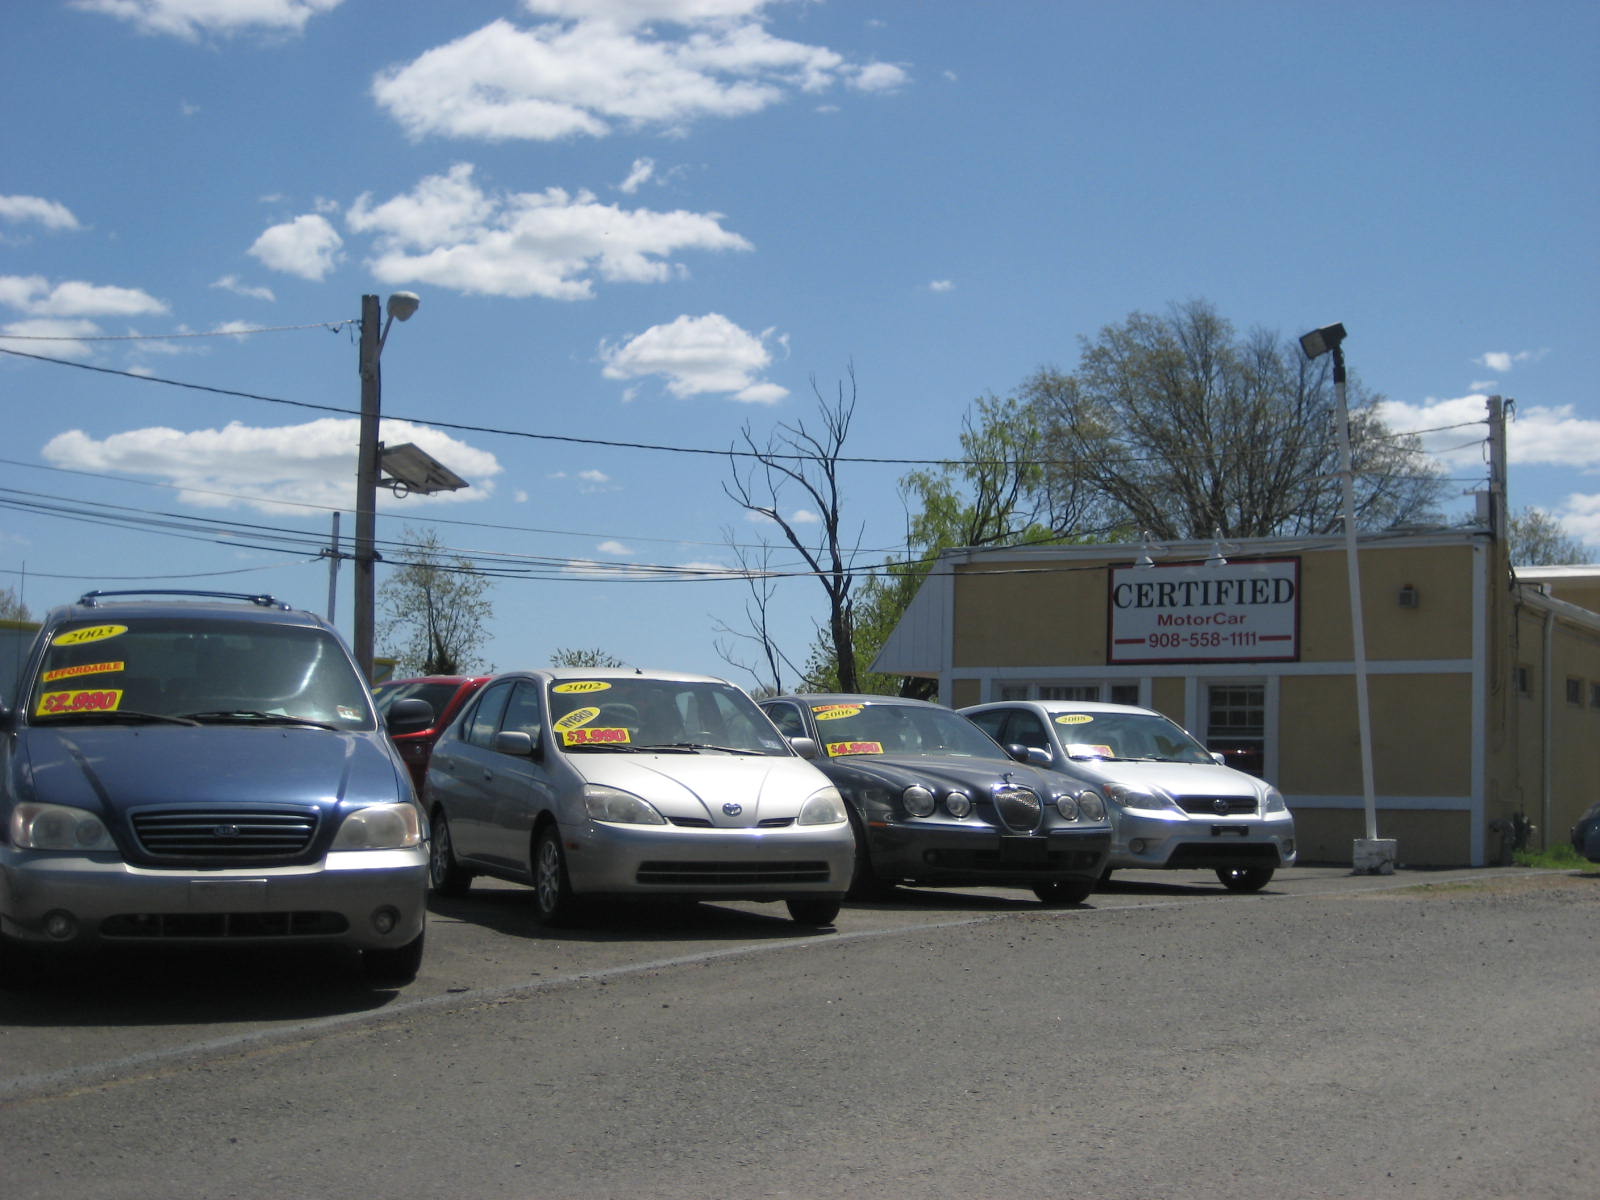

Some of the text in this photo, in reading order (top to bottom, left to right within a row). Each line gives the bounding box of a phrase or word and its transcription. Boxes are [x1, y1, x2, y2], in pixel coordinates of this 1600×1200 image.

[1114, 577, 1295, 609] CERTIFIED
[1157, 612, 1247, 627] MotorCar
[65, 626, 115, 644] 2003
[1149, 631, 1257, 648] 908-558-1111
[47, 661, 121, 681] AFFORDABLE
[565, 682, 603, 692] 2002
[559, 709, 594, 729] HYBRID
[824, 709, 853, 719] 2006
